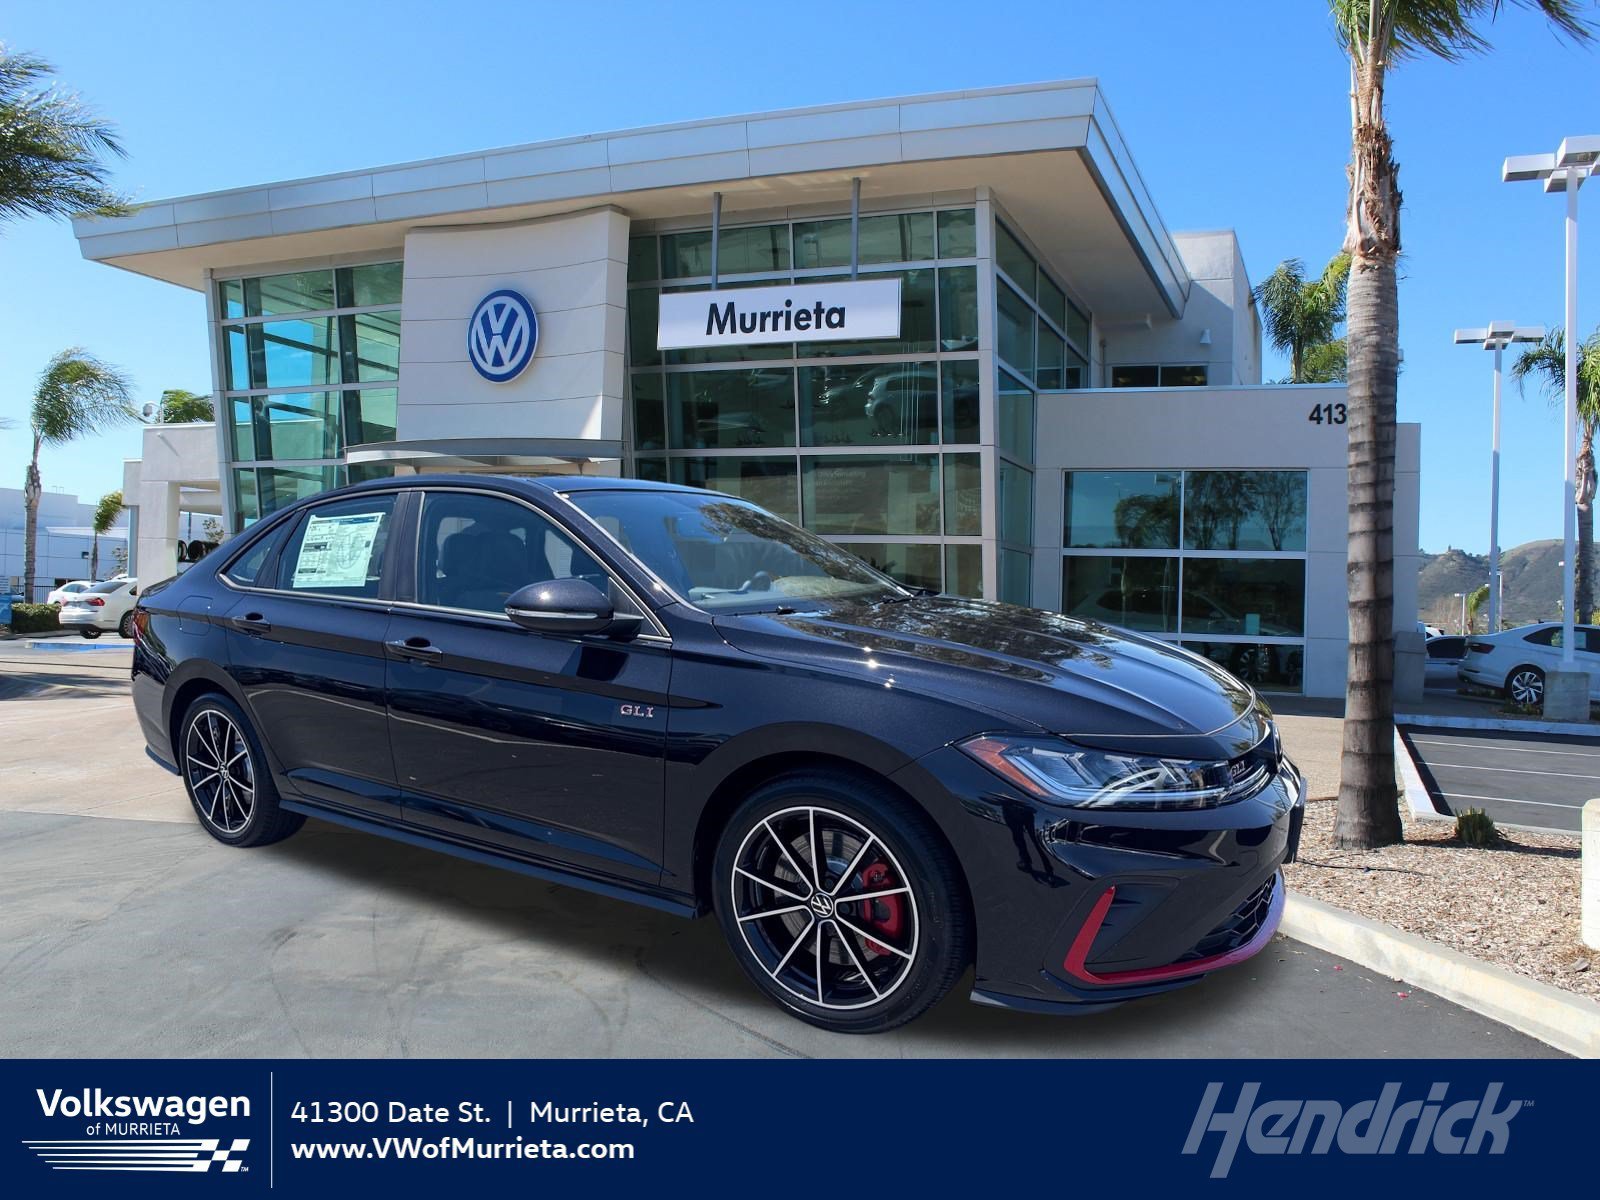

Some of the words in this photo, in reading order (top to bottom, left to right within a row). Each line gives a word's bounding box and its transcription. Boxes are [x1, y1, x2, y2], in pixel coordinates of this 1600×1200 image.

[705, 298, 846, 336] Murrieta
[1308, 403, 1347, 425] 413
[620, 703, 655, 718] GLI
